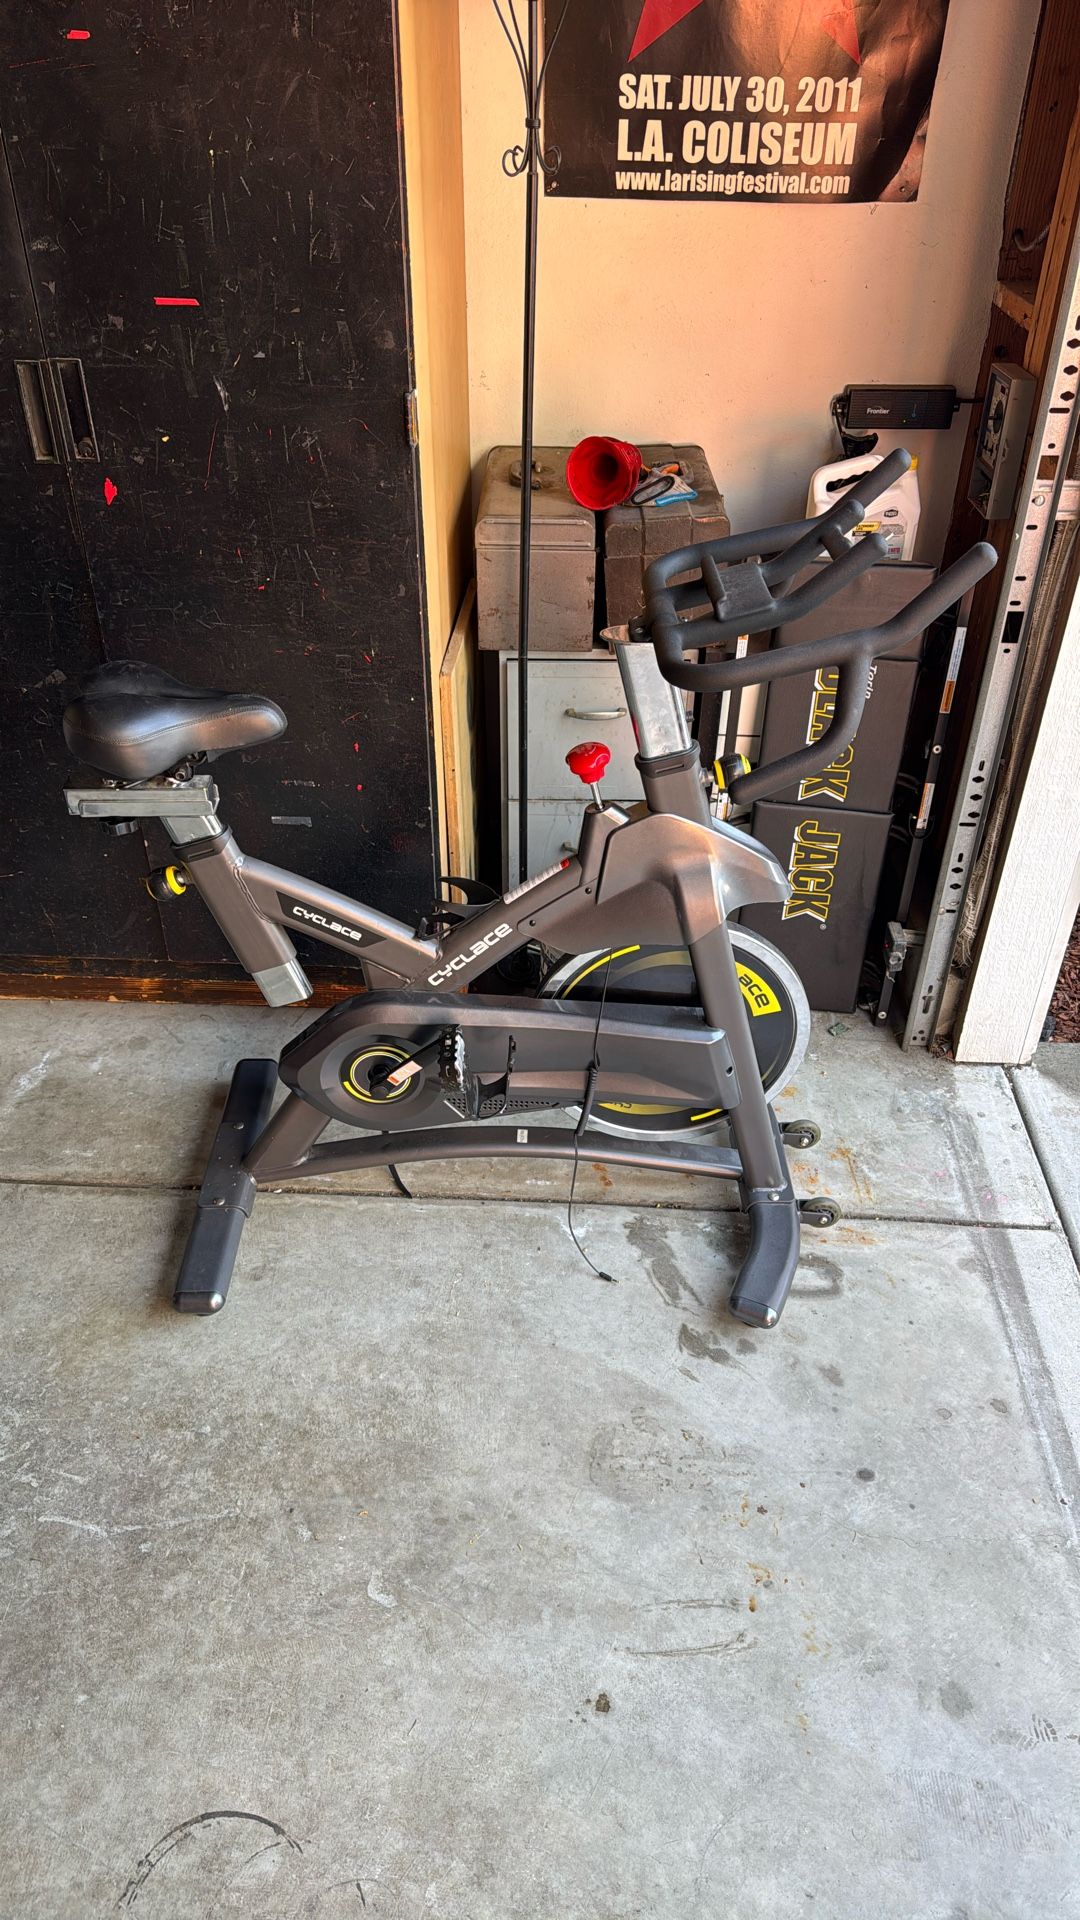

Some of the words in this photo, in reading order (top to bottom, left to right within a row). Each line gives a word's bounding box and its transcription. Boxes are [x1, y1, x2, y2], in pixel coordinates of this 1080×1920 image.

[619, 73, 673, 110] SAT.
[678, 75, 742, 112] JULY
[746, 76, 790, 116] 30,
[795, 76, 863, 113] 2011
[617, 118, 674, 163] L.A.
[682, 119, 858, 166] COLISEUM
[615, 169, 851, 196] www.larisingfestival.com
[866, 407, 890, 415] Frontier
[782, 820, 841, 922] JACK
